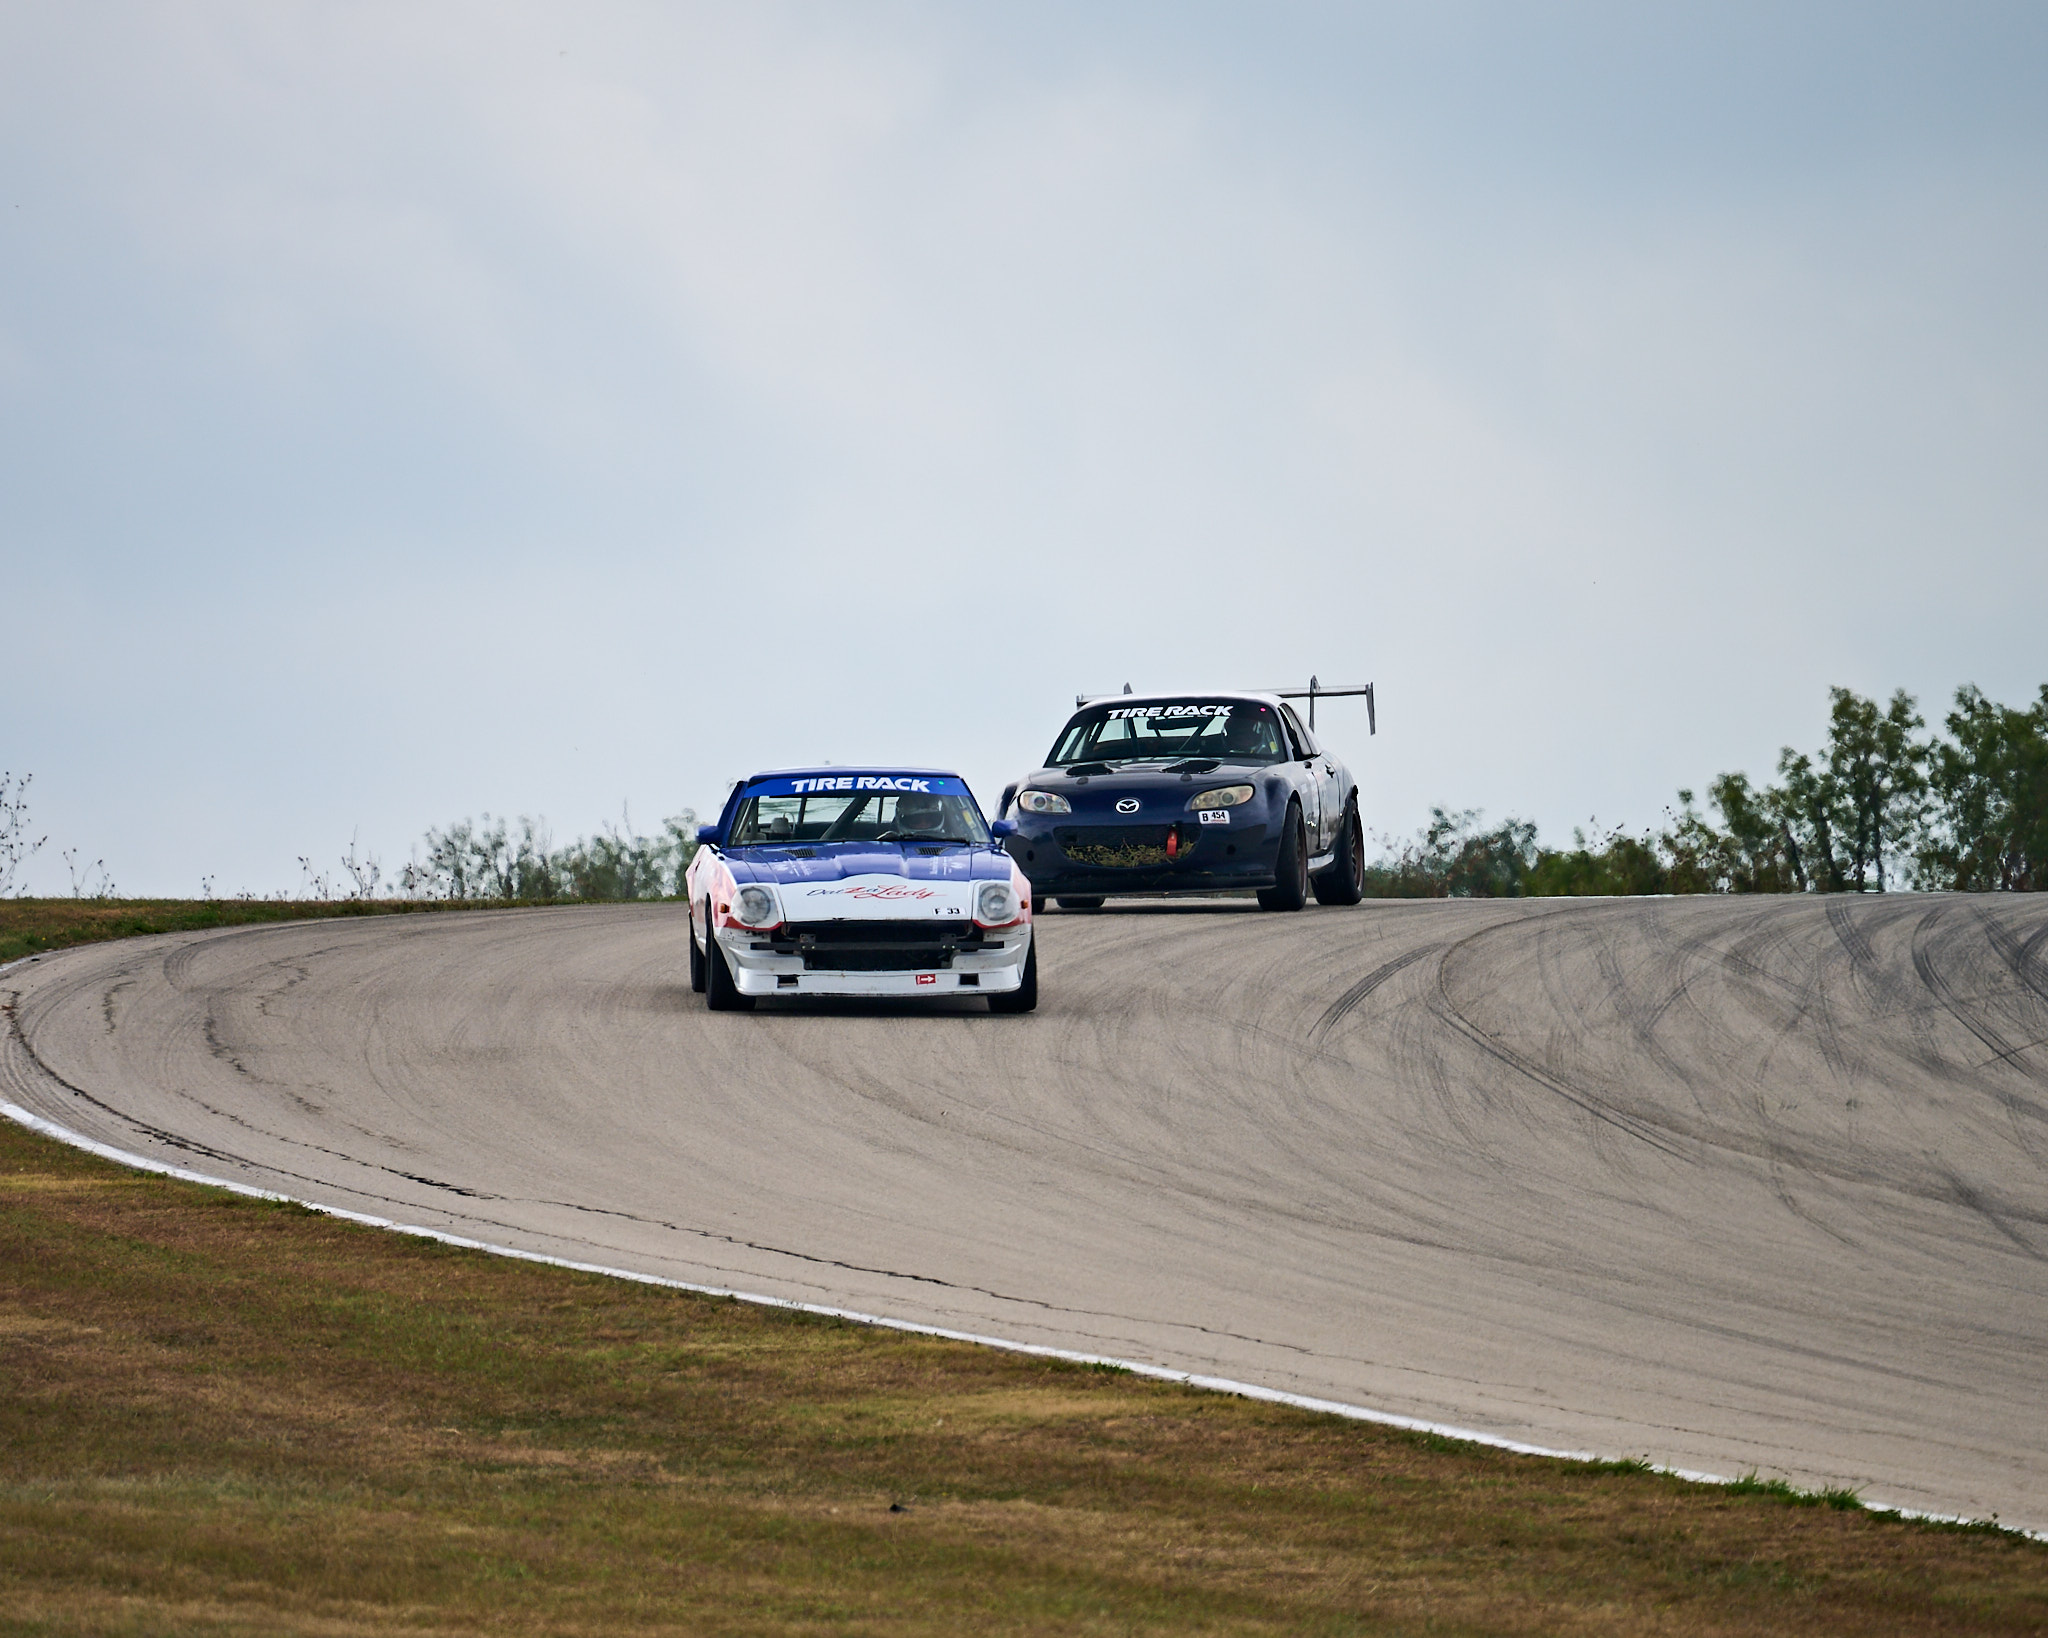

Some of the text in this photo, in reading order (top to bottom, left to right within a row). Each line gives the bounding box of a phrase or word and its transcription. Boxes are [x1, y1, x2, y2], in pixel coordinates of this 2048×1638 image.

[1108, 705, 1234, 720] TIRE RACK
[791, 777, 930, 793] TIRE RACK
[1202, 813, 1209, 821] B
[1211, 811, 1226, 820] 454
[946, 907, 960, 915] 33
